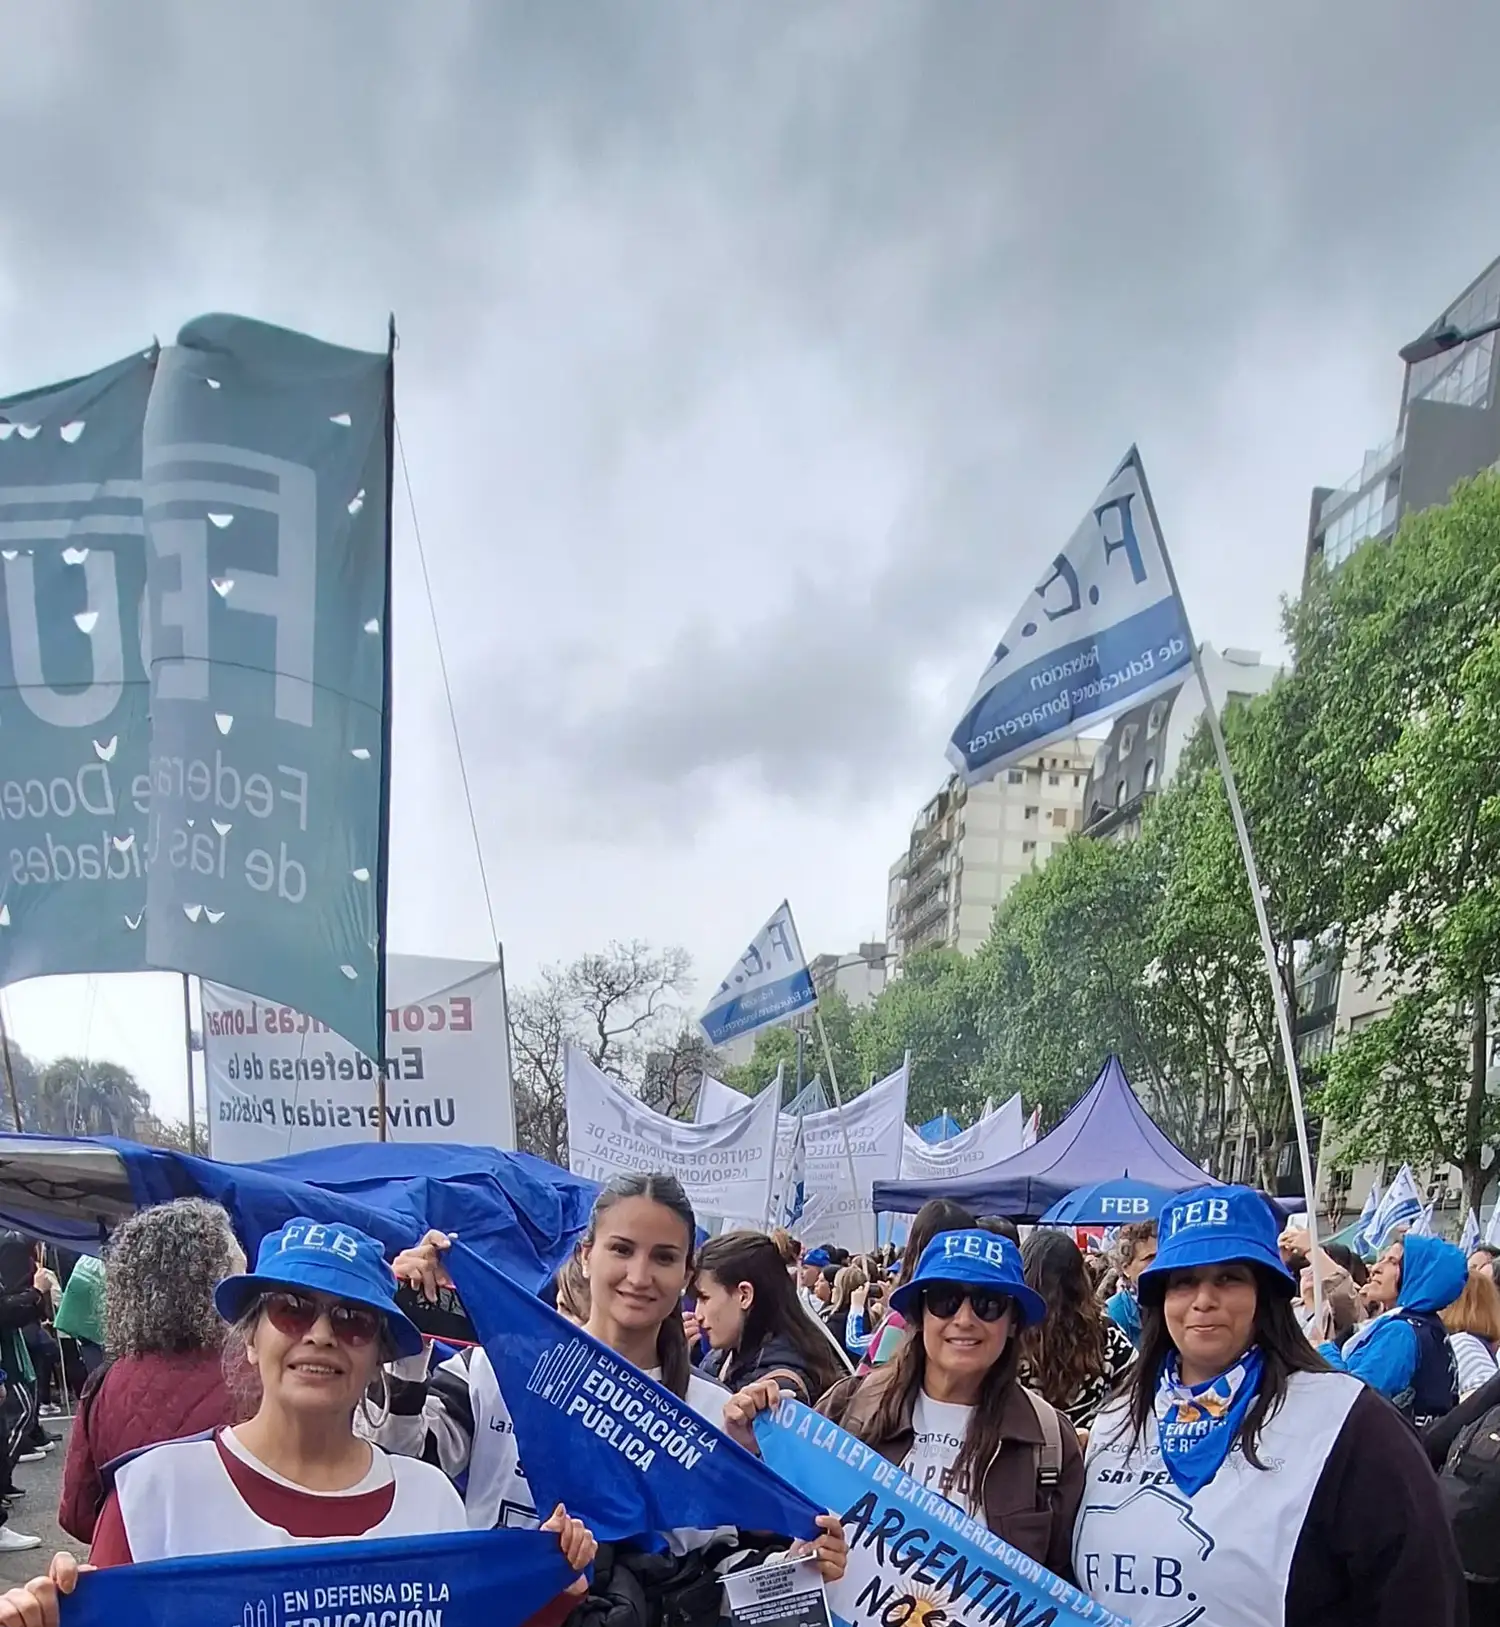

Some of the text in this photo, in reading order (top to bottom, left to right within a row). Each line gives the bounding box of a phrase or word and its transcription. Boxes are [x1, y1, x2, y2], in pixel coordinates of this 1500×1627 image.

[1100, 1197, 1149, 1214] FEB
[1171, 1199, 1228, 1235] FEB
[281, 1224, 358, 1257] FEB
[944, 1236, 1003, 1264] FEB
[582, 1369, 702, 1470] EDUCACIÓN
[597, 1355, 719, 1453] EN DEFENSA DE LA
[566, 1395, 656, 1472] PÚBLICA
[769, 1400, 797, 1428] NO
[796, 1413, 812, 1438] A
[812, 1421, 838, 1453] LA
[836, 1436, 876, 1472] LEY
[872, 1462, 899, 1489] DE
[894, 1475, 1045, 1584] EXTRANJERIZACION
[1048, 1579, 1073, 1604] DE
[1071, 1593, 1094, 1618] LA
[283, 1583, 449, 1613] EN DEFENSA DE LA
[1083, 1553, 1198, 1602] F.E.B.
